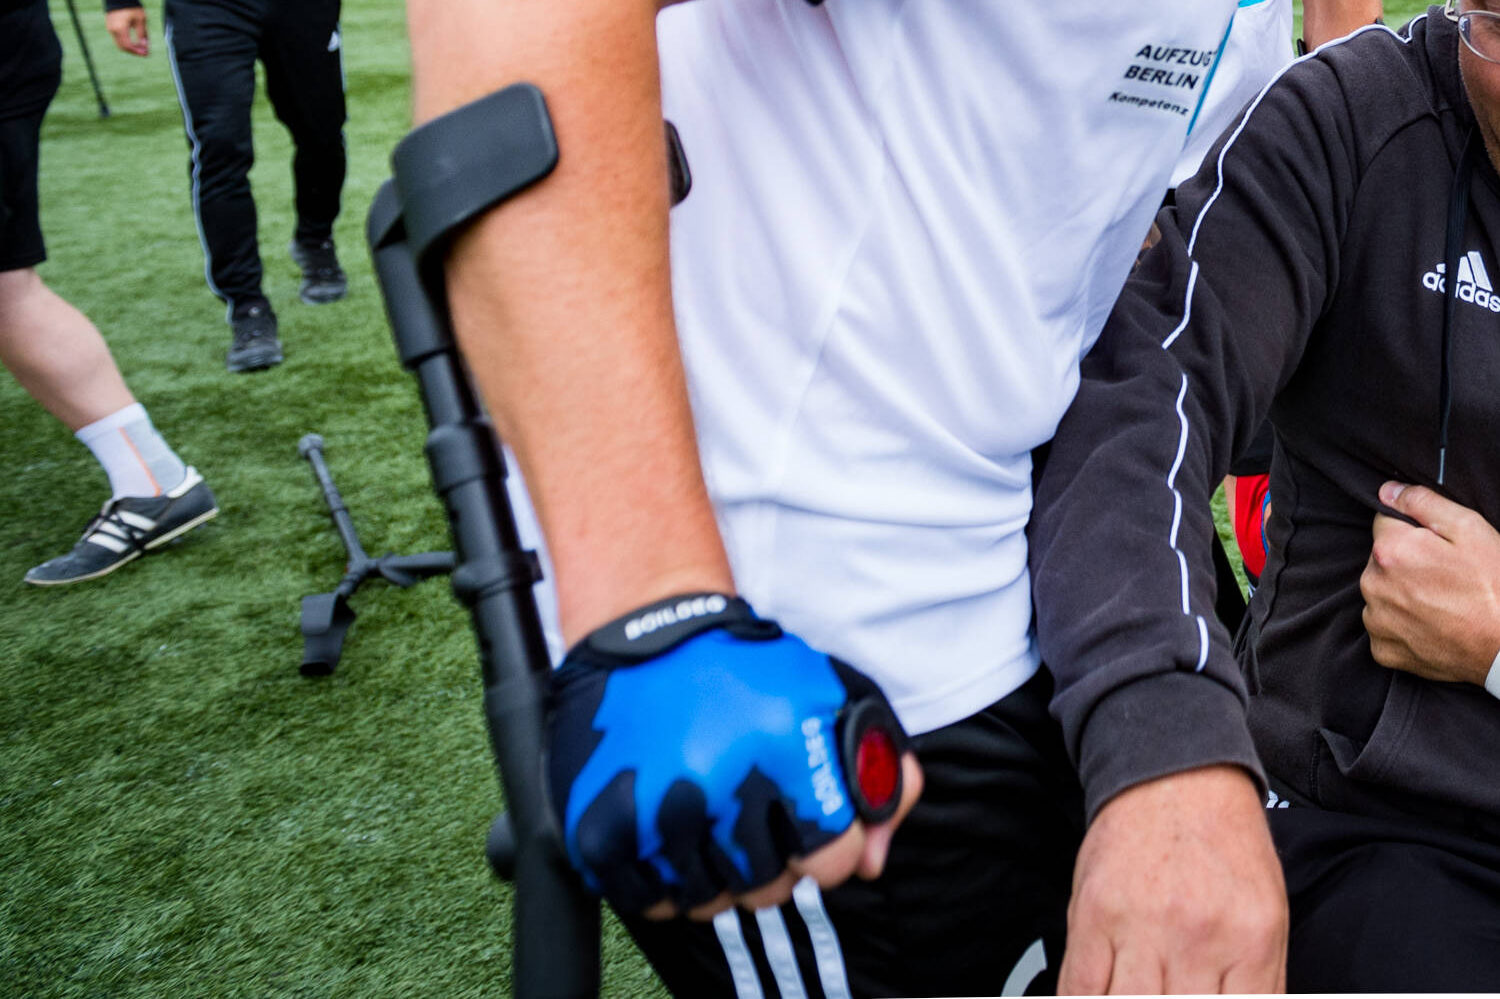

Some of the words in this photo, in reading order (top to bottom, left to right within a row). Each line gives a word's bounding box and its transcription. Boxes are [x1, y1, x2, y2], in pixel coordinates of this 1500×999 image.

[1135, 43, 1219, 67] AUFZUG
[1123, 65, 1200, 90] BERLIN
[1108, 91, 1190, 117] Kompetenz
